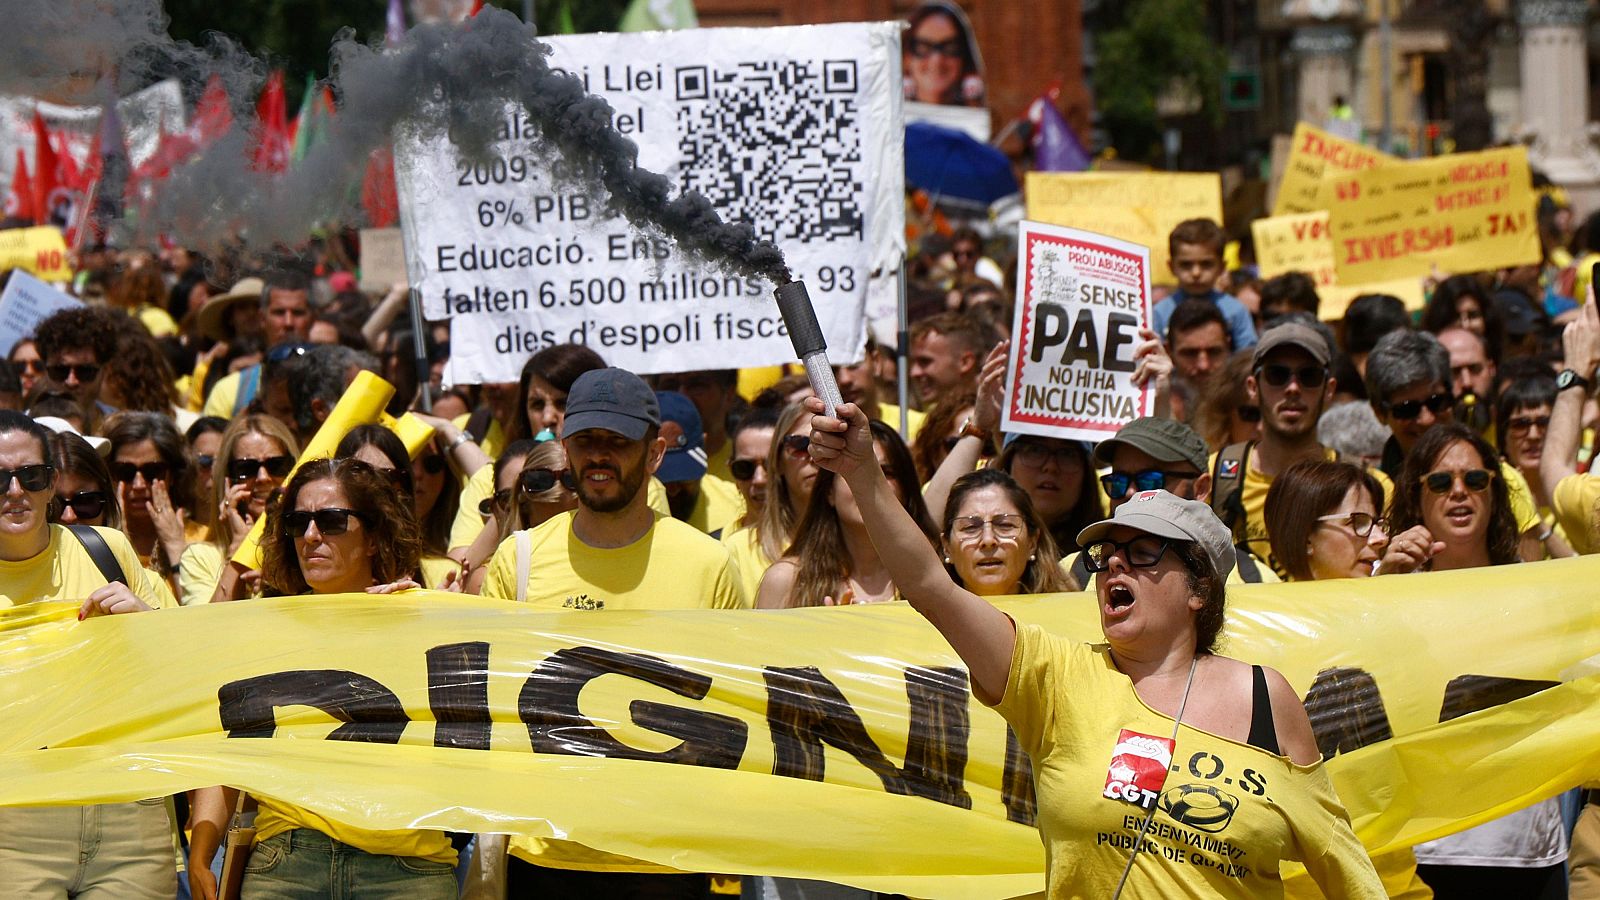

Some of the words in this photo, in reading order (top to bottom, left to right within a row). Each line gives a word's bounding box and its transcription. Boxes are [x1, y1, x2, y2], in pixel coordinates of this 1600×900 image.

[604, 63, 663, 92] Llei
[606, 107, 643, 134] el
[457, 155, 539, 187] 2009:
[477, 199, 524, 228] 6%
[536, 194, 590, 223] PIB
[437, 235, 593, 272] Educació.
[1069, 251, 1097, 267] PROU
[443, 286, 528, 314] falten
[539, 277, 625, 308] 6.500
[640, 272, 762, 302] milions
[818, 265, 855, 293] 93
[1080, 283, 1138, 312] SENSE
[495, 325, 555, 353] dies
[1030, 302, 1138, 372] PAE
[1049, 366, 1073, 385] NO
[1076, 370, 1091, 388] HI
[1094, 371, 1116, 391] HA
[1023, 384, 1136, 420] INCLUSIVA
[1171, 752, 1274, 803] .O.S.
[1104, 781, 1158, 808] CGT
[1097, 831, 1159, 855] PÚBLIC
[1163, 846, 1185, 863] DE
[1123, 814, 1247, 860] ENSENYAMENT
